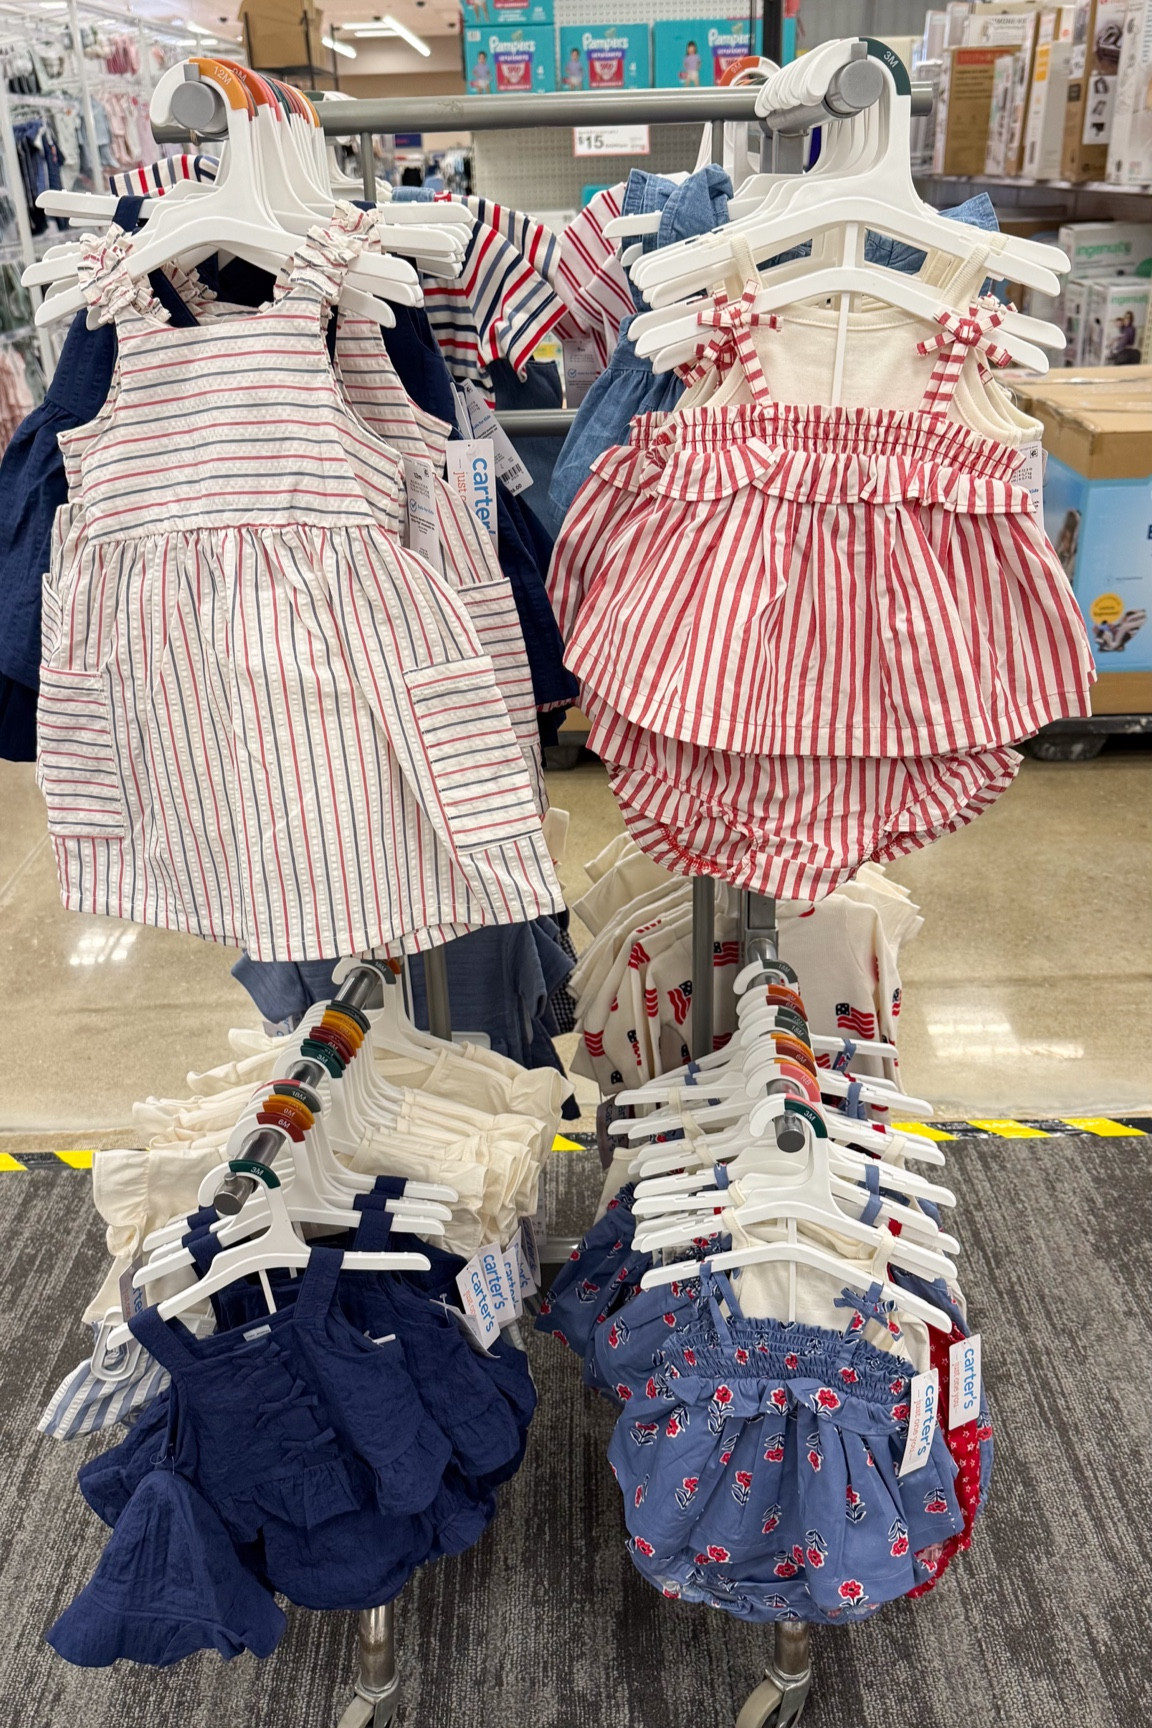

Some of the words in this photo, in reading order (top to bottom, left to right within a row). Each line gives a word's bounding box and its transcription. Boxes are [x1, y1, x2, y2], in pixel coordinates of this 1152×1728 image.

[488, 35, 535, 54] Pampers
[582, 32, 629, 51] Pampers
[883, 51, 899, 68] 3M
[213, 66, 232, 85] 12M
[578, 135, 604, 149] $15
[453, 471, 468, 493] just
[472, 457, 497, 534] carter'
[316, 1053, 329, 1064] 3M
[801, 1074, 812, 1086] NB
[291, 1090, 307, 1101] 18M
[278, 1119, 291, 1129] 6M
[803, 1110, 816, 1122] 3M
[250, 1166, 264, 1177] 3M
[483, 1254, 508, 1310] carter's
[471, 1271, 495, 1333] carter's
[963, 1348, 977, 1410] carter's
[917, 1384, 934, 1456] carter's
